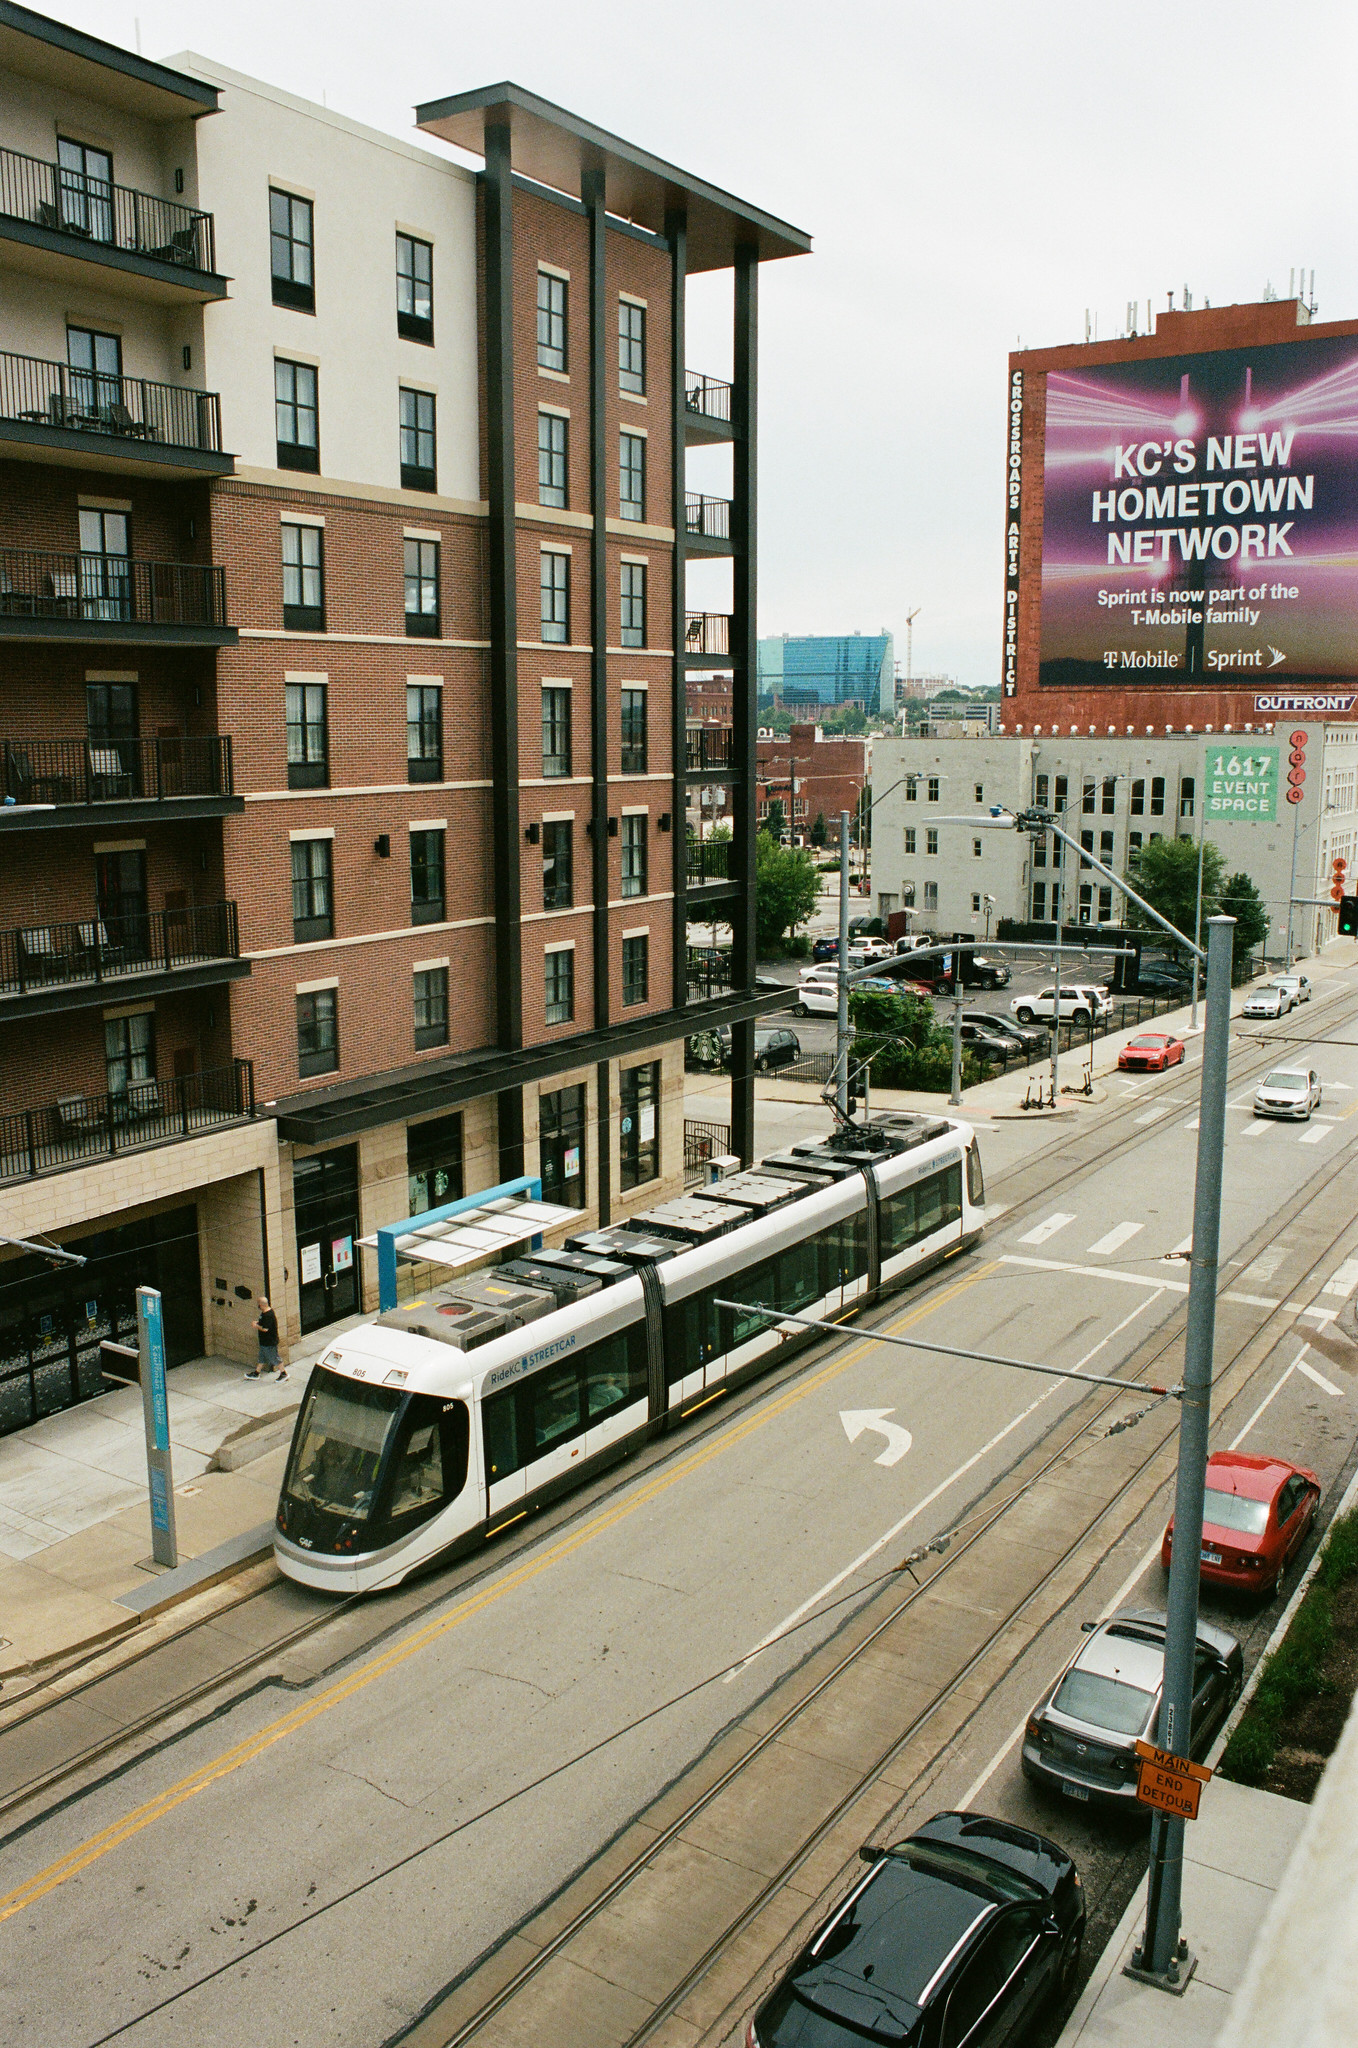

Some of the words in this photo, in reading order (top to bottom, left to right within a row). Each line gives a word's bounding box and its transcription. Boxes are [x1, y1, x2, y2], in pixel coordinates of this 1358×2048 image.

[1009, 371, 1023, 510] CROSSROADS
[1114, 438, 1196, 478] KC'S
[1206, 431, 1295, 471] NEW
[1092, 475, 1314, 523] HOMETOWN
[1007, 522, 1020, 577] ARTS
[1107, 522, 1295, 564] NETWORK
[1098, 588, 1147, 607] Sprint
[1151, 588, 1166, 603] is
[1169, 589, 1205, 603] now
[1208, 586, 1245, 606] part
[1248, 585, 1267, 600] of
[1269, 584, 1299, 599] the
[1131, 608, 1202, 625] T-Mobile
[1206, 608, 1260, 625] family
[1005, 590, 1018, 697] DISTRICT
[1120, 651, 1178, 668] Mobile
[1207, 649, 1263, 671] Sprint
[1258, 697, 1349, 710] OUTFRONT
[1213, 755, 1271, 777] 1617
[1213, 781, 1270, 795] EVENT
[1210, 798, 1270, 812] SPACE
[491, 1362, 520, 1384] RideKC
[529, 1335, 576, 1366] STREETCAR
[352, 1368, 367, 1378] 805
[442, 1402, 454, 1413] 805
[1154, 1750, 1190, 1773] MAIN
[1156, 1773, 1183, 1792] END
[1142, 1784, 1193, 1808] DETOUR
